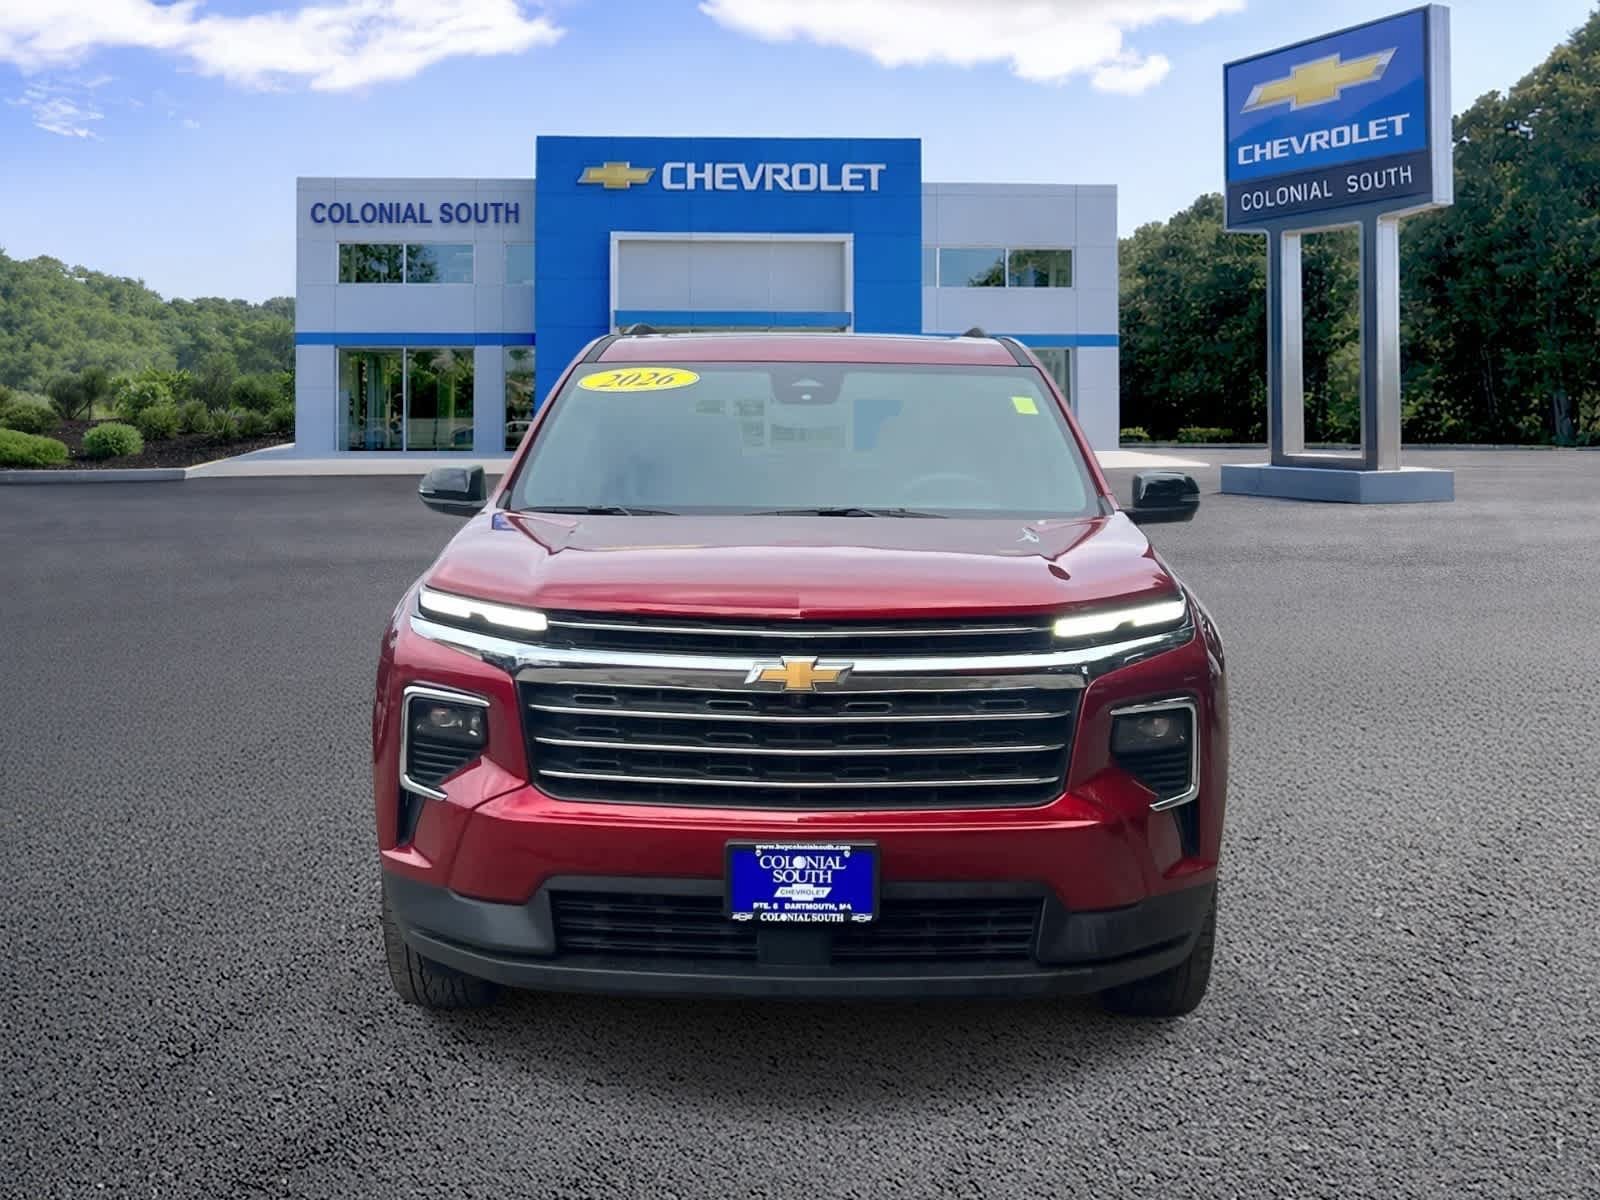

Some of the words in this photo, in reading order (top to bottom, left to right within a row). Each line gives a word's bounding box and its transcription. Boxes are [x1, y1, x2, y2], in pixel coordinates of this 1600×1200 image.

[1237, 112, 1410, 166] CHEVROLET
[662, 162, 887, 192] CHEVROLET
[1241, 179, 1333, 212] COLONIAL
[1346, 165, 1413, 193] SOUTH
[310, 202, 433, 225] COLONIAL
[439, 202, 520, 225] SOUTH
[597, 372, 675, 388] 2026
[759, 855, 847, 869] COLONIAL
[772, 870, 832, 883] SOUTH
[780, 888, 825, 896] CHEVROLET
[839, 903, 852, 911] MA
[760, 913, 811, 922] COLONIAL
[811, 913, 844, 923] SOUTH
